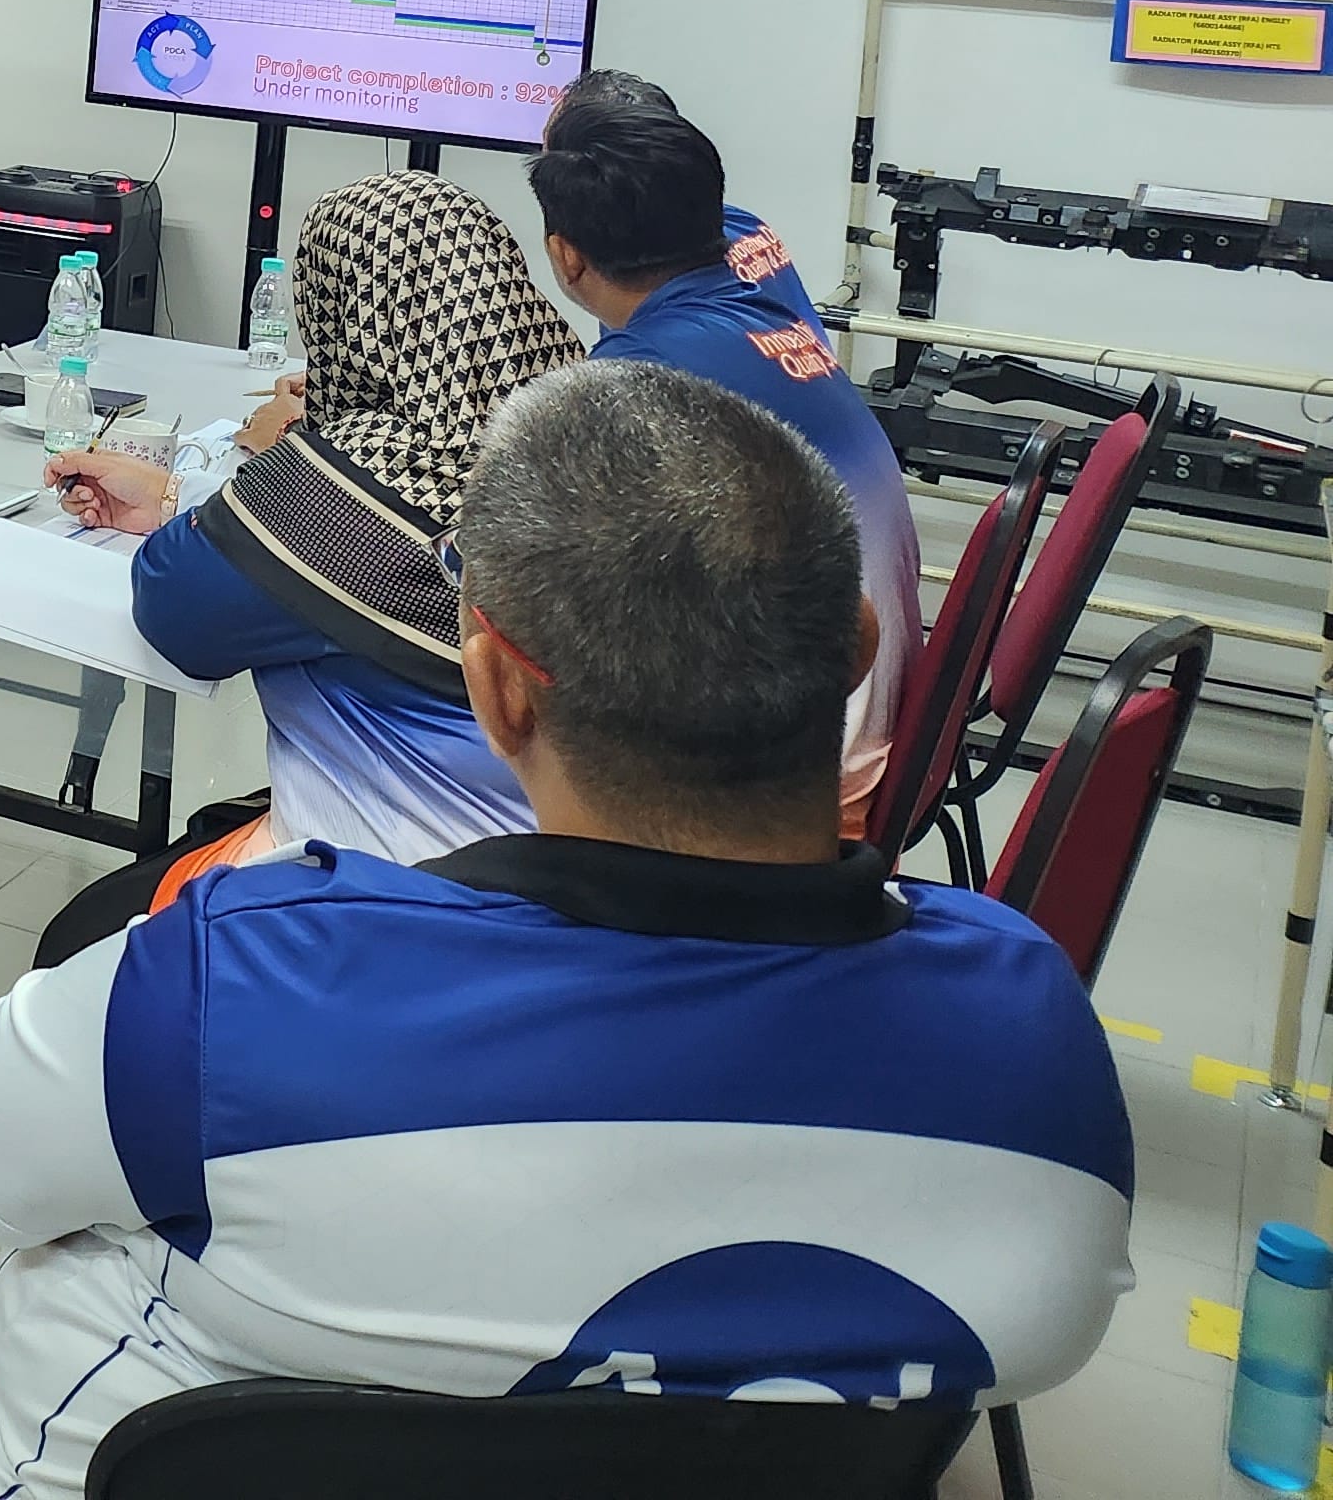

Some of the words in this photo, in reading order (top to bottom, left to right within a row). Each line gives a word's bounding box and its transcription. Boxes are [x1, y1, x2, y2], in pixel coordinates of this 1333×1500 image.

[1147, 9, 1187, 19] RADIATOR
[1188, 12, 1215, 21] FRAME
[1218, 14, 1237, 22] ASSY
[146, 24, 161, 38] ACT
[185, 23, 204, 40] PLAN
[1152, 35, 1191, 45] RADIATOR
[1193, 38, 1220, 47] FRAME
[1222, 40, 1242, 48] ASSY
[164, 46, 186, 56] PDCA
[255, 54, 342, 83] Project
[347, 68, 494, 98] completion
[253, 77, 311, 98] Under
[315, 86, 420, 114] monitoring
